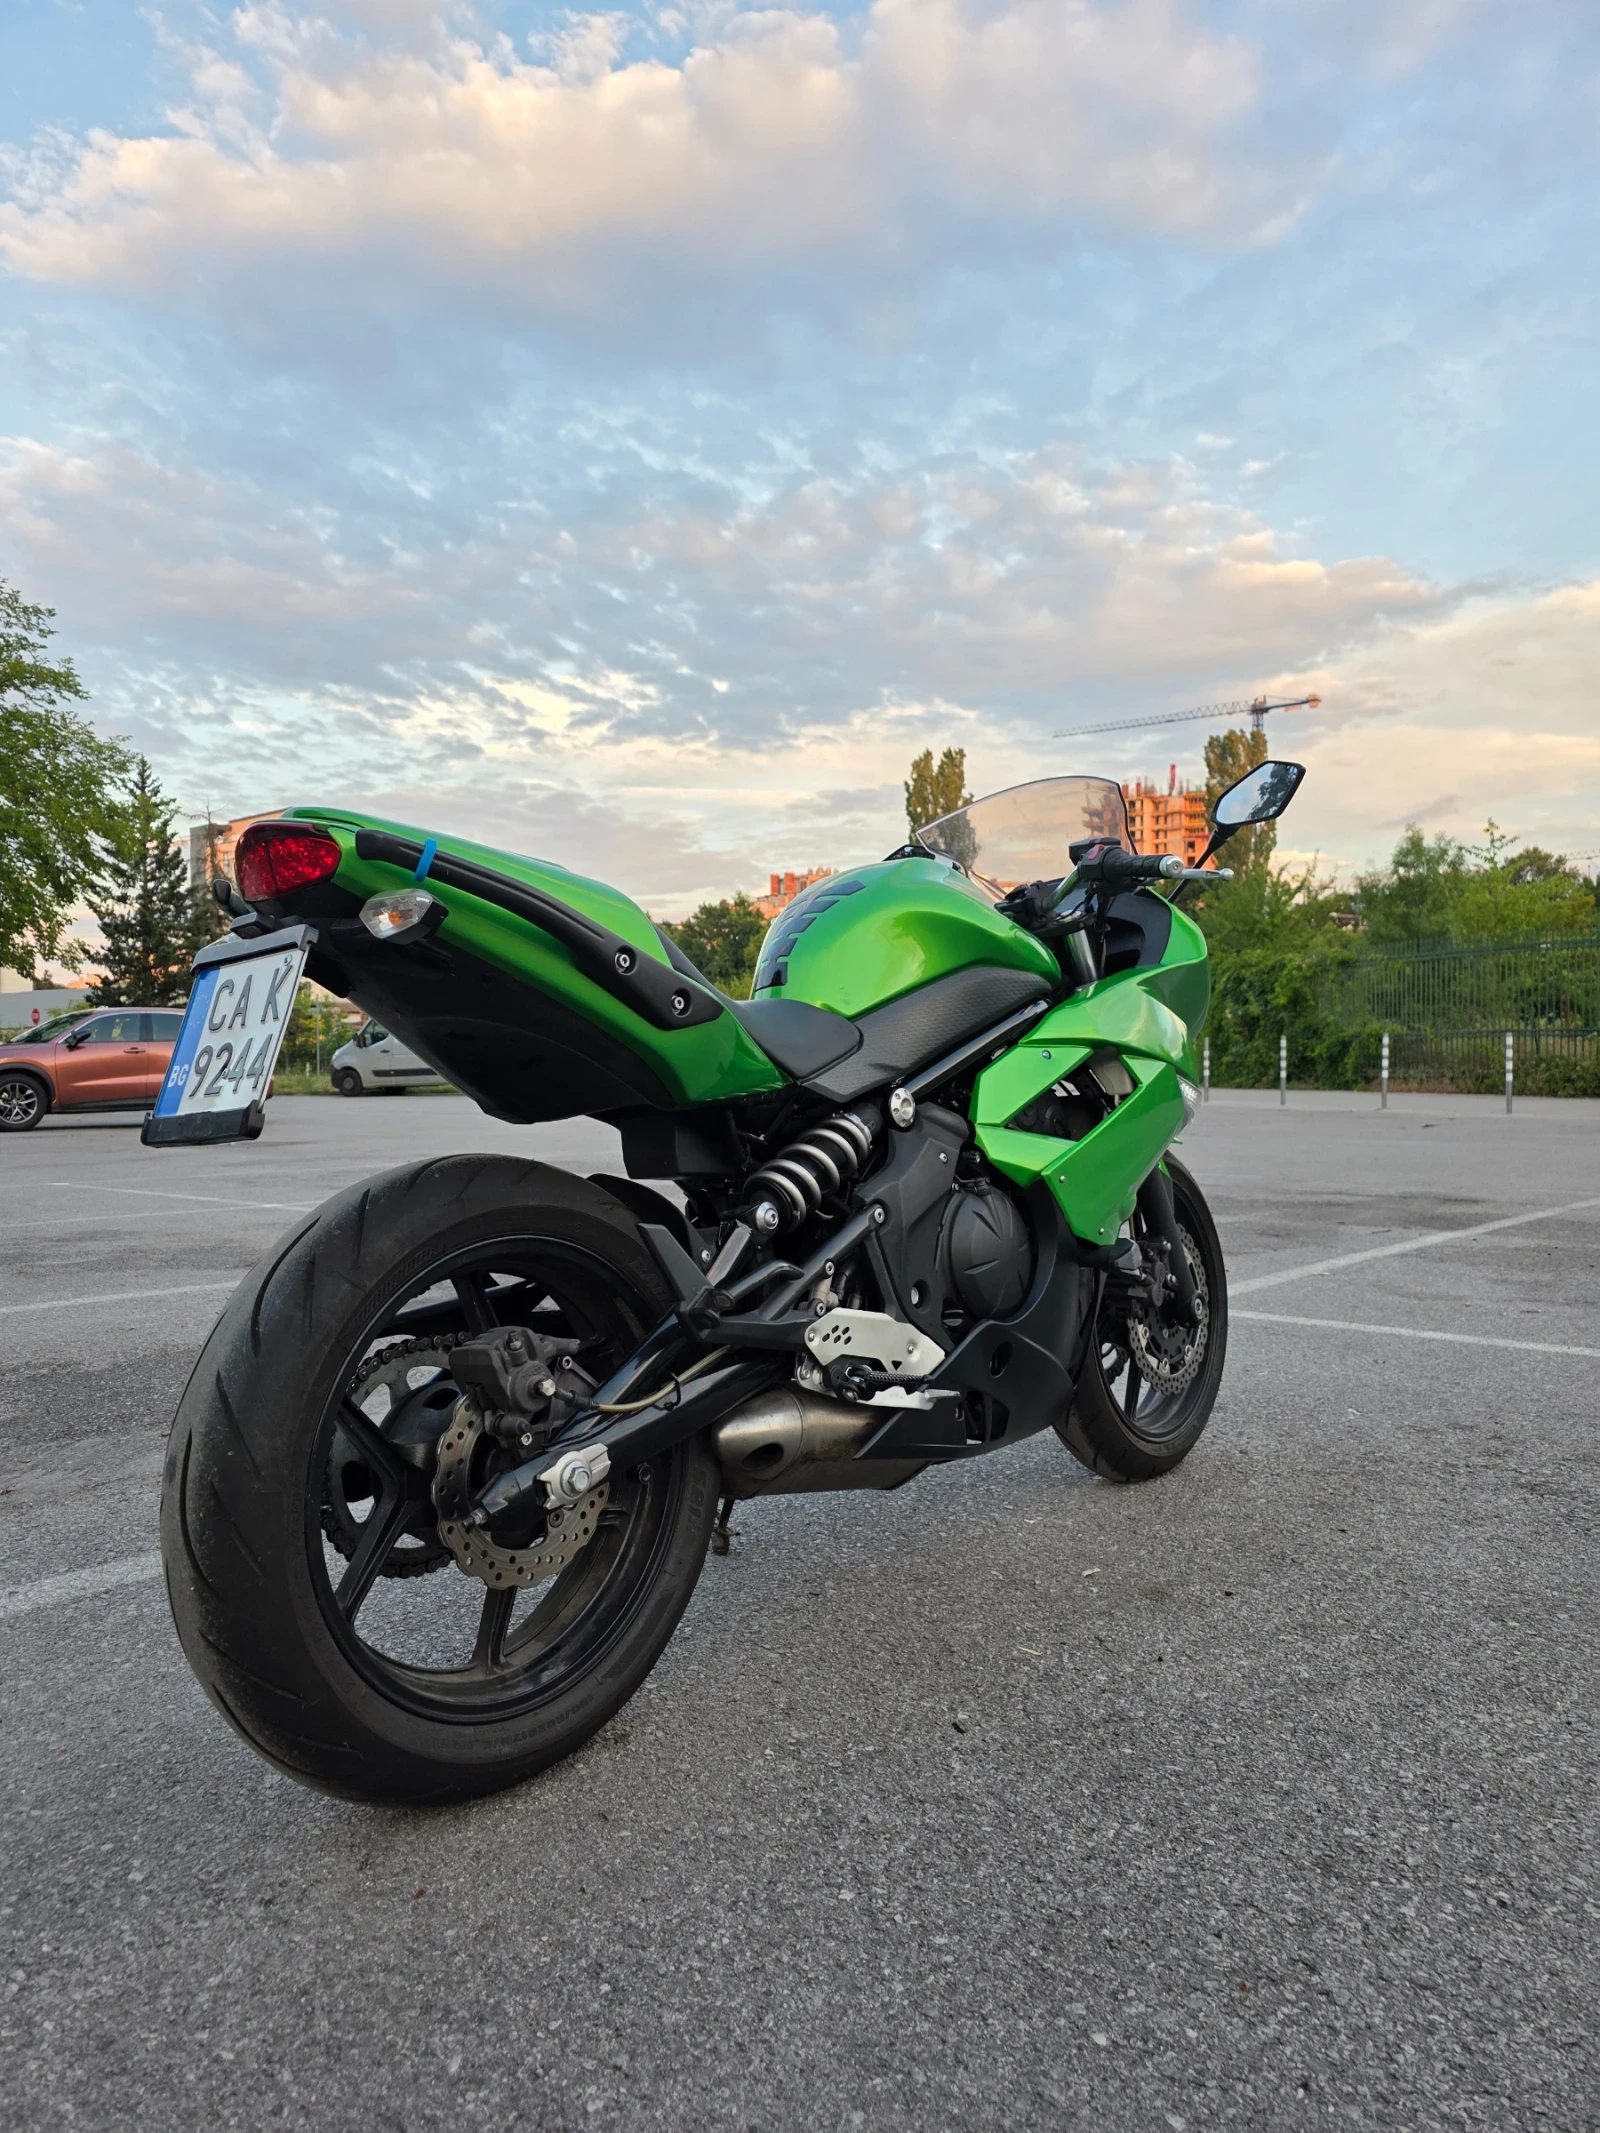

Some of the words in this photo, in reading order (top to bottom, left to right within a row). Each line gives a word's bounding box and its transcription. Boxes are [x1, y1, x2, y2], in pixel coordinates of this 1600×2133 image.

[208, 974, 254, 1032] CA
[260, 964, 293, 1024] K
[167, 1064, 189, 1088] BG
[188, 1034, 273, 1098] 9244
